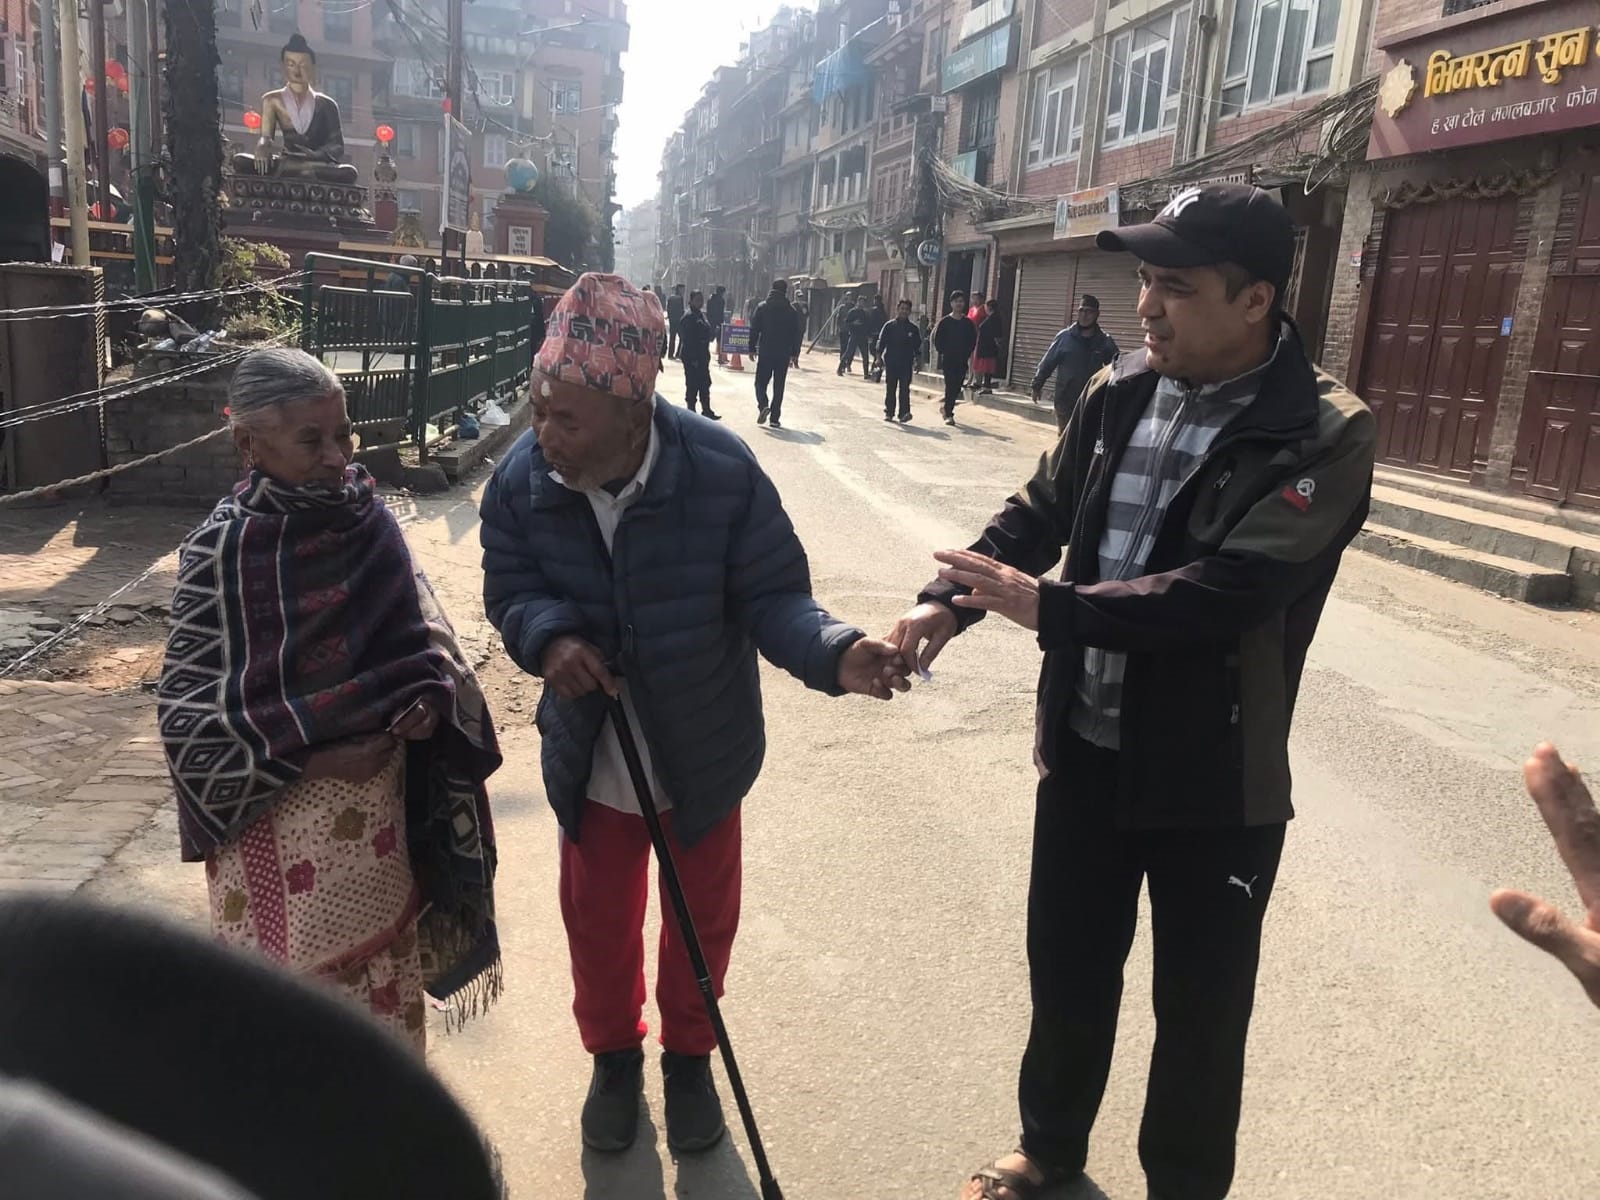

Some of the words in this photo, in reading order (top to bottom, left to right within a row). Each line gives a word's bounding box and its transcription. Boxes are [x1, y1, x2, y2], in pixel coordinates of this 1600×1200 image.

[1535, 26, 1591, 85] सुन
[1461, 107, 1486, 128] टोल
[1566, 85, 1599, 108] फोन
